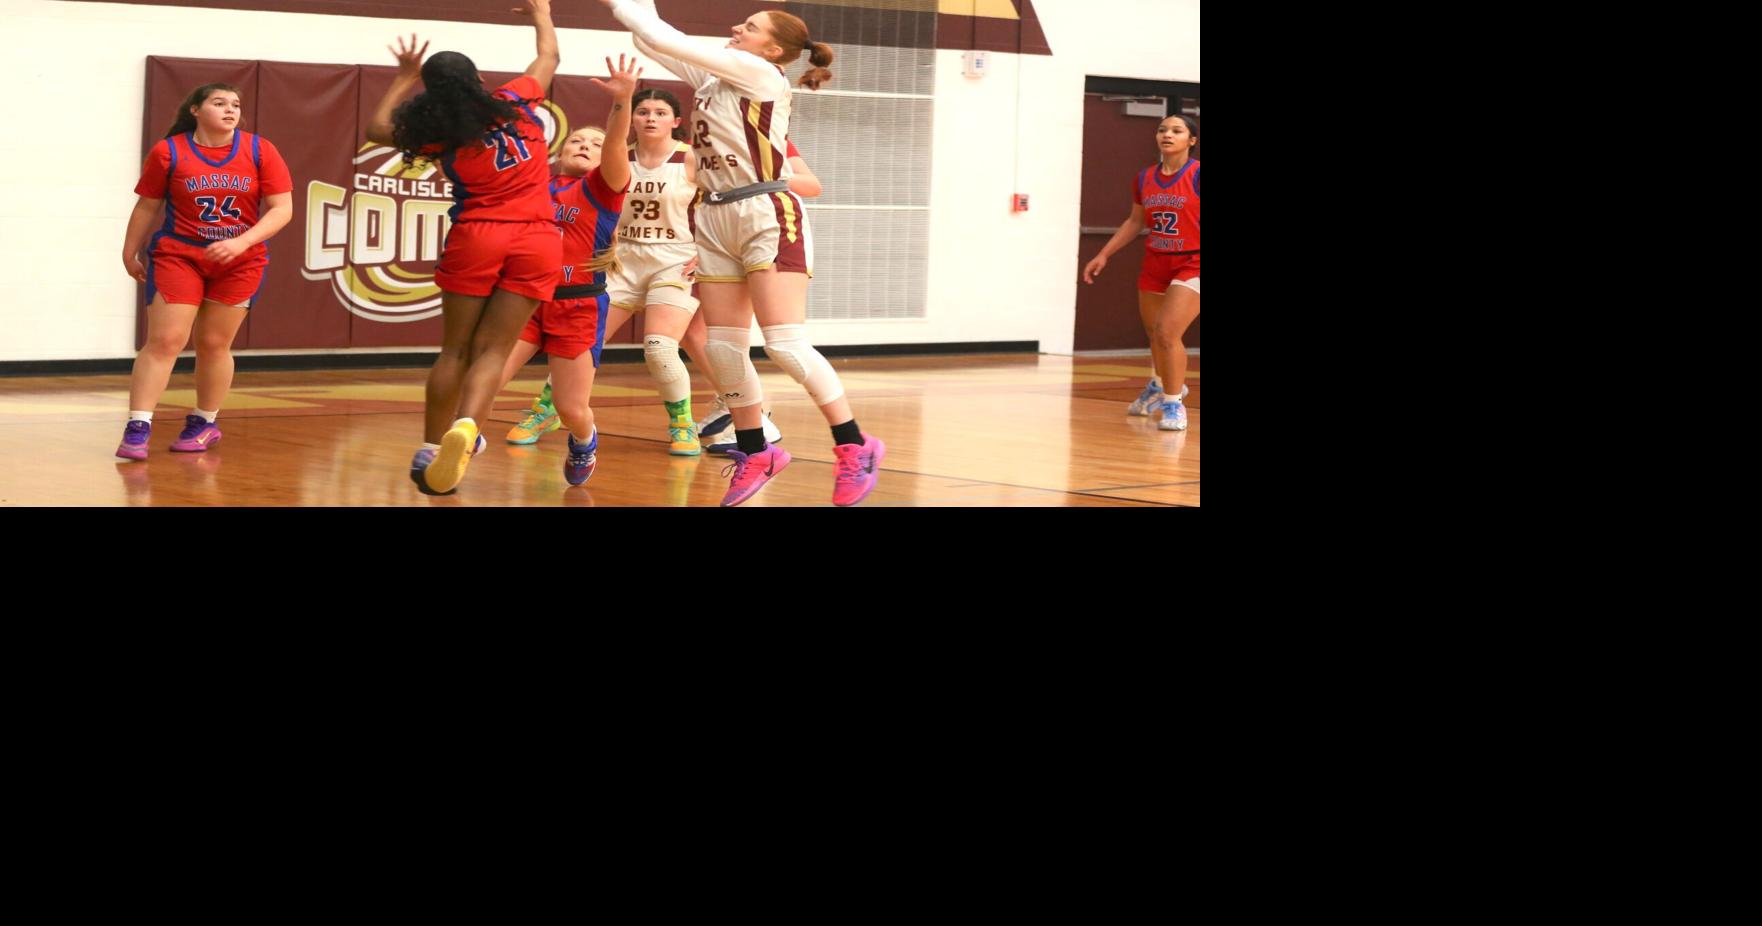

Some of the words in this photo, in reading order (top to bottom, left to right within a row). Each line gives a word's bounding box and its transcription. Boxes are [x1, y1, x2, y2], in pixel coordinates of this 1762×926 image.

[484, 122, 532, 172] 21
[185, 174, 251, 193] MASSAC
[354, 173, 453, 198] CARLISLE
[626, 181, 667, 194] ADY
[195, 196, 241, 222] 24
[305, 180, 456, 271] COM
